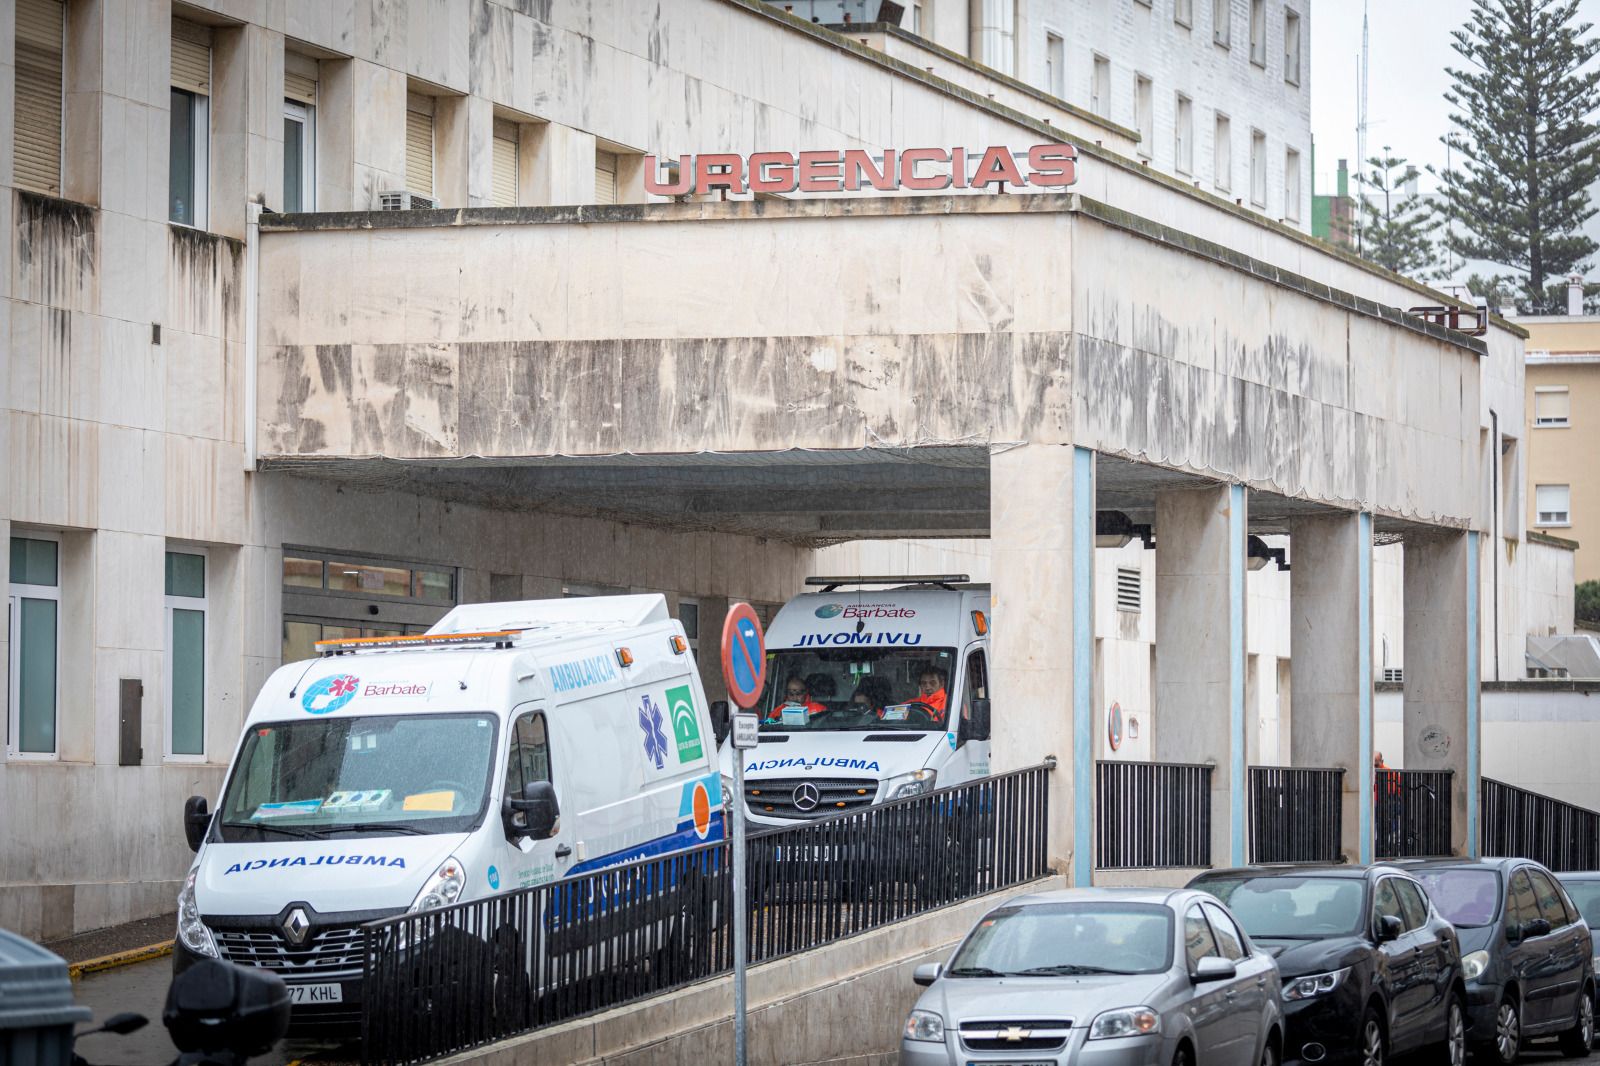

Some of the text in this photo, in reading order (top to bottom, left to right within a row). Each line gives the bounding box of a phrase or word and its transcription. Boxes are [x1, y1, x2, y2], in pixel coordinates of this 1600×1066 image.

[643, 143, 1078, 197] URGENCIAS
[842, 606, 916, 619] Barbate
[549, 654, 617, 693] AMBULANCIA
[364, 683, 427, 697] Barbate
[287, 986, 338, 1001] 77 KHL
